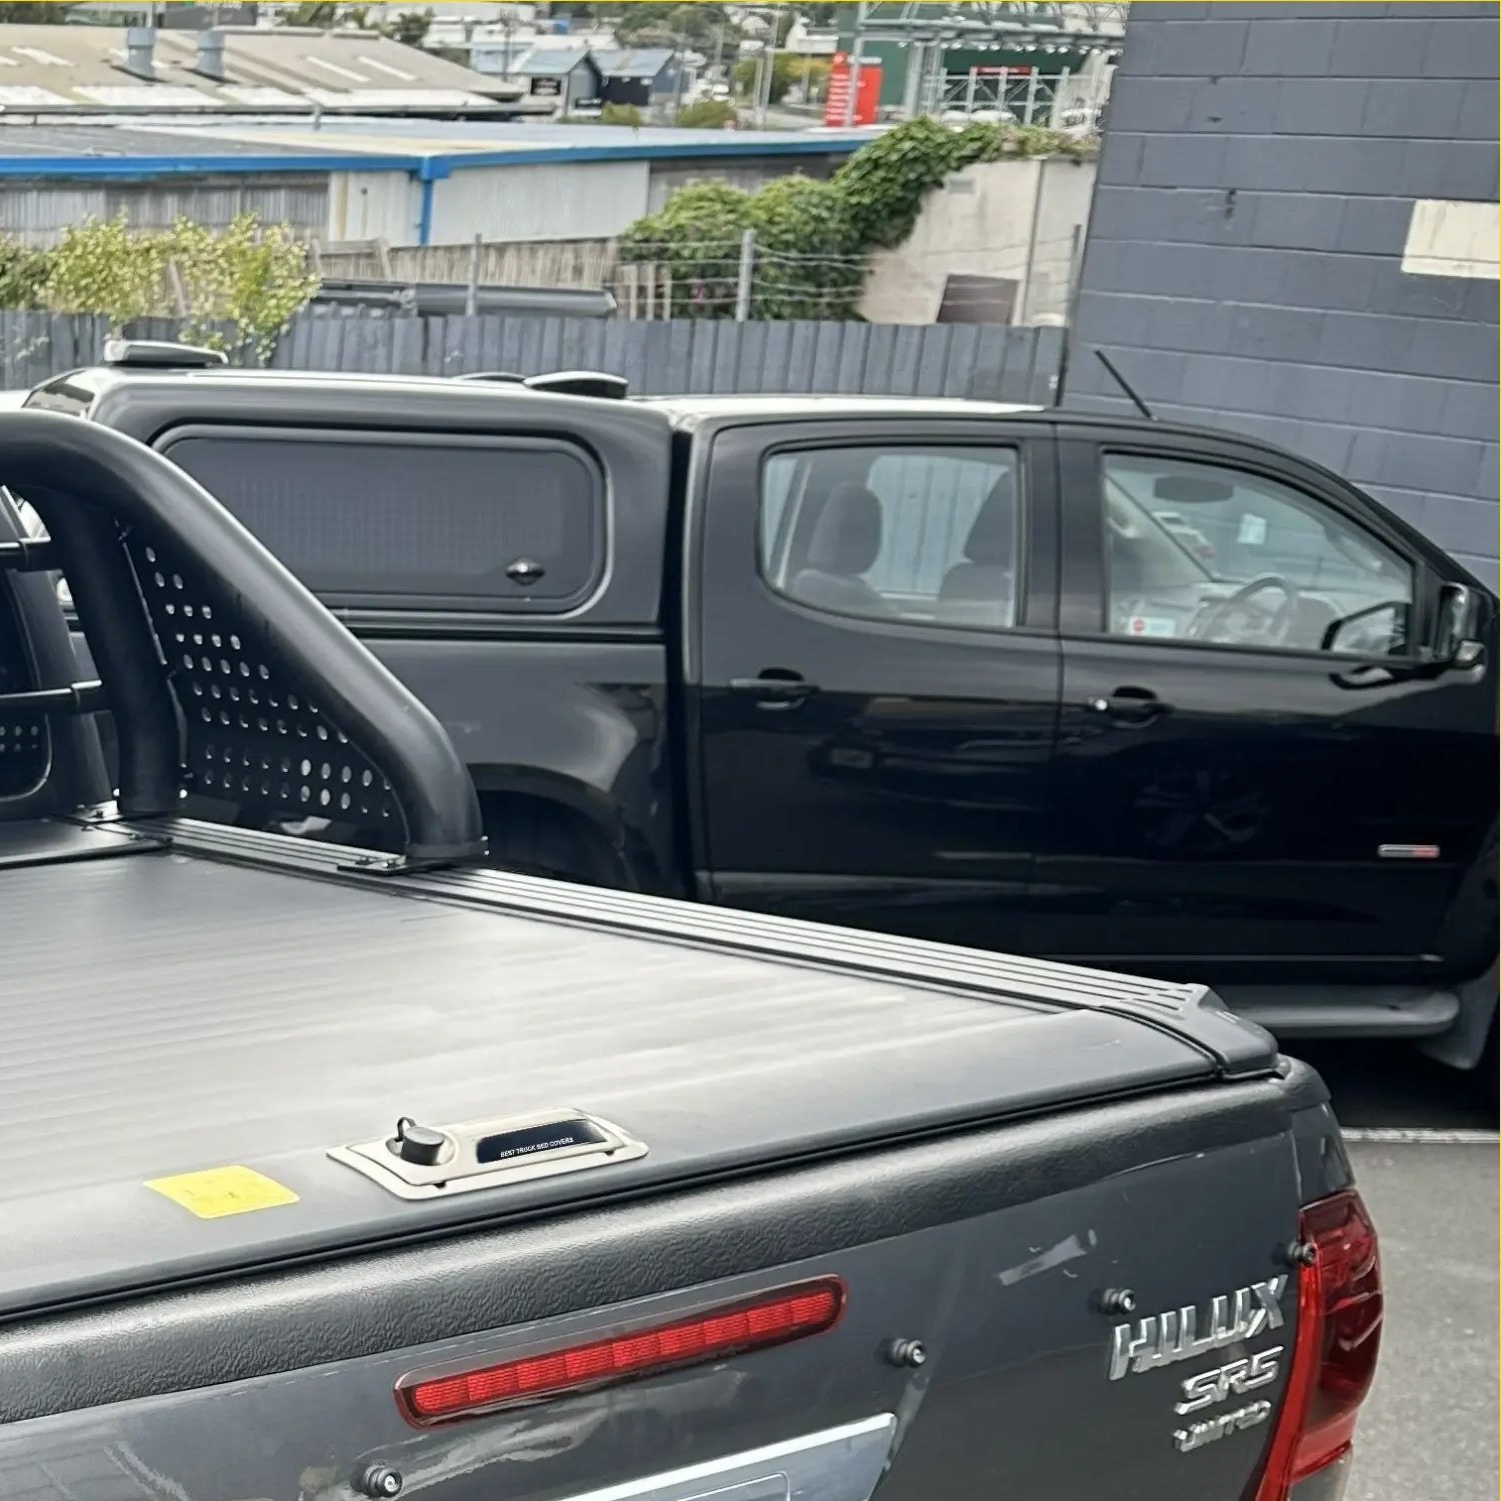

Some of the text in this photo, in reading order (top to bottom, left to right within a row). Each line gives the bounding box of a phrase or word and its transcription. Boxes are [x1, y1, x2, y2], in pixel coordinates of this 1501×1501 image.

[500, 1149, 516, 1158] BEST
[516, 1144, 537, 1155] TRUCK
[1109, 1273, 1289, 1381] HILUX
[1174, 1345, 1284, 1415] SR5
